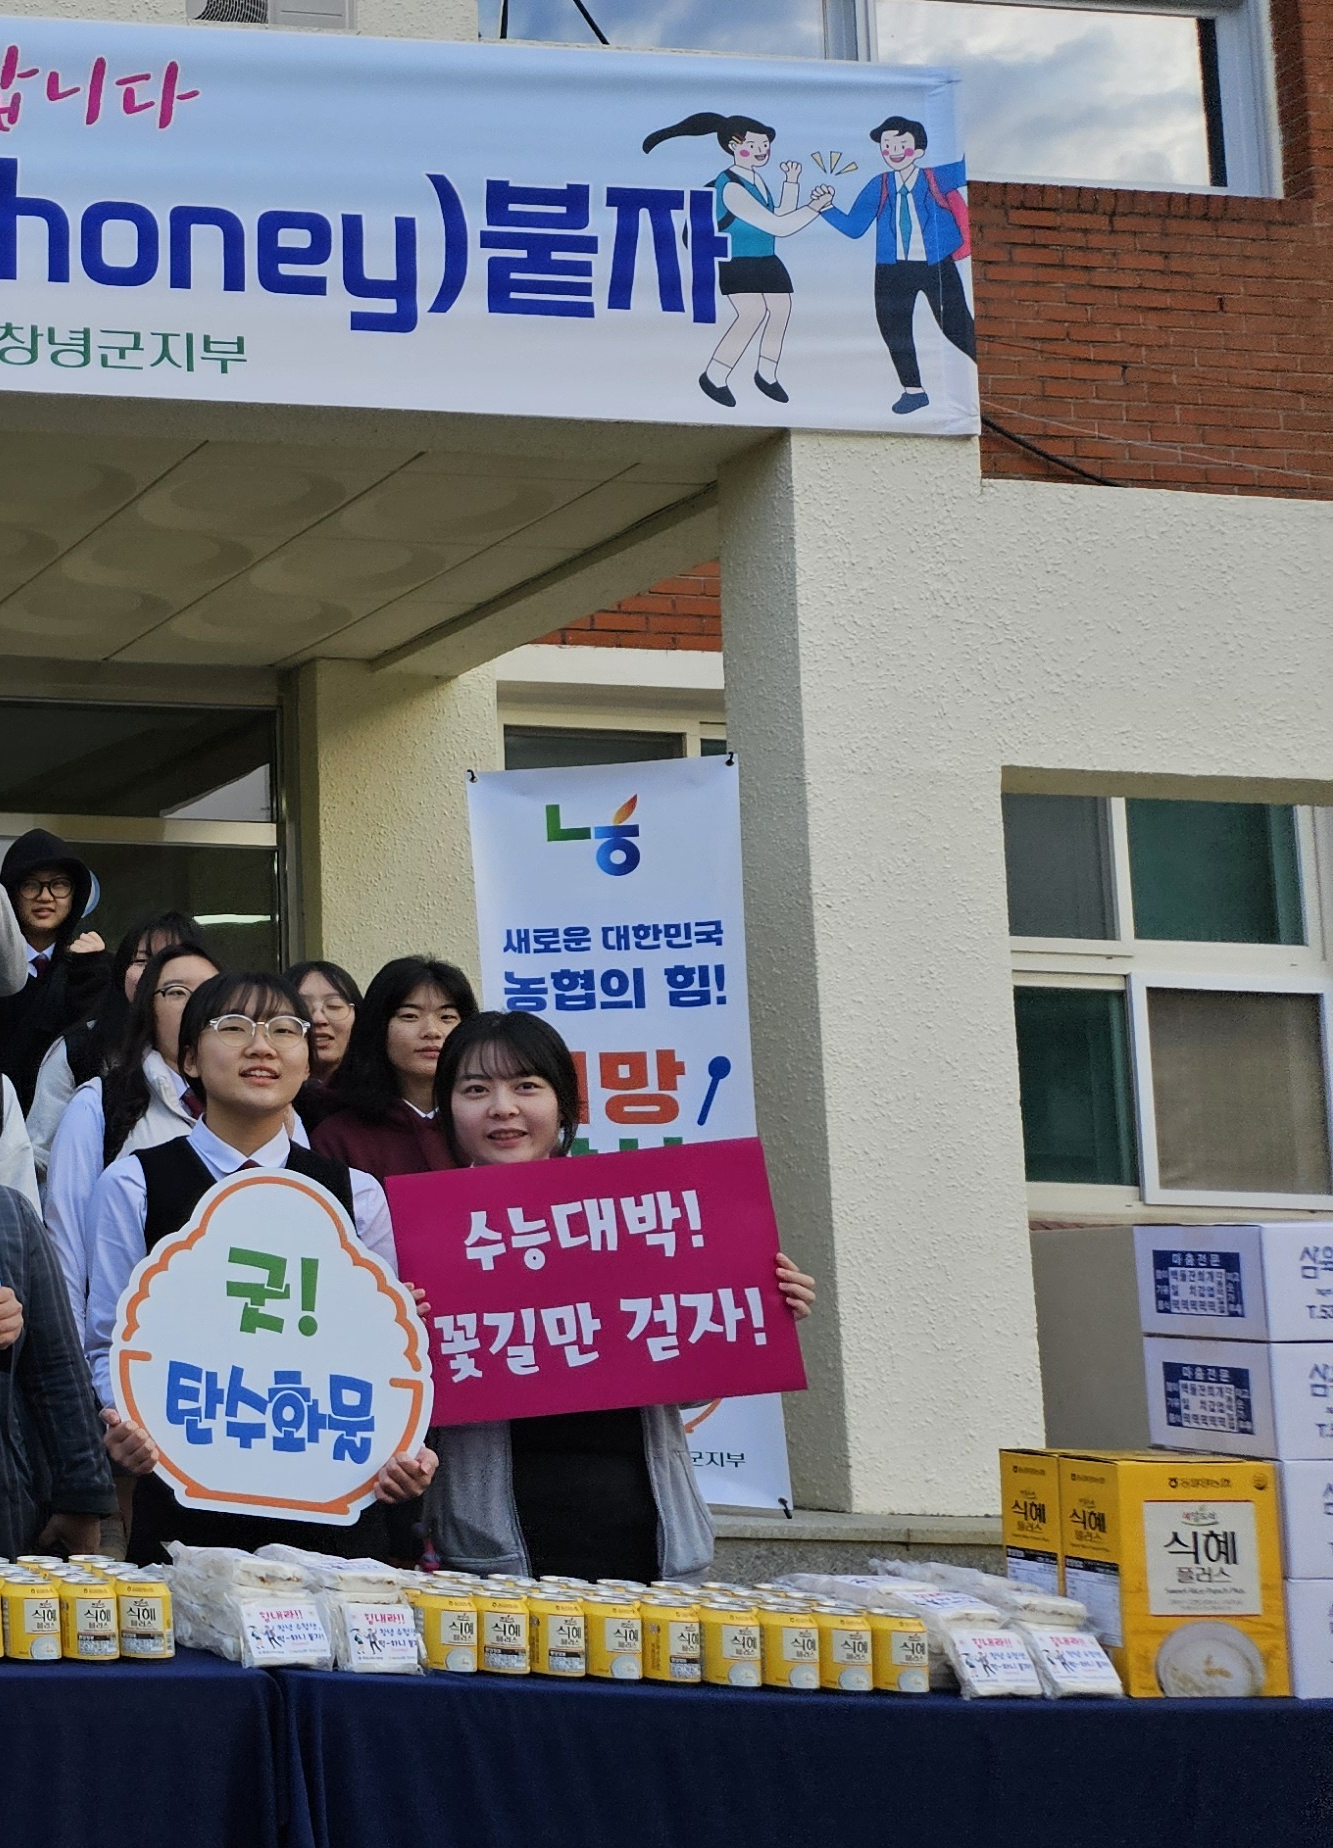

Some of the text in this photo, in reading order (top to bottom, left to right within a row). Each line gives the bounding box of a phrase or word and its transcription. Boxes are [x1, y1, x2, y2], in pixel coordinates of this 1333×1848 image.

[503, 920, 723, 954] 새로운 대한민국
[503, 964, 727, 1012] 농협의 힘!
[576, 1050, 685, 1124] 망
[464, 1190, 703, 1270] 수능대박!
[226, 1247, 319, 1336] 굿!
[434, 1287, 767, 1383] 꽃길만 걷자!
[1309, 1364, 1333, 1398] 삼
[166, 1360, 375, 1464] 탄수화물
[1011, 1501, 1046, 1523] 식혜
[1069, 1510, 1106, 1533] 식혜
[1164, 1530, 1238, 1564] 식혜
[1177, 1566, 1233, 1583] 플러스
